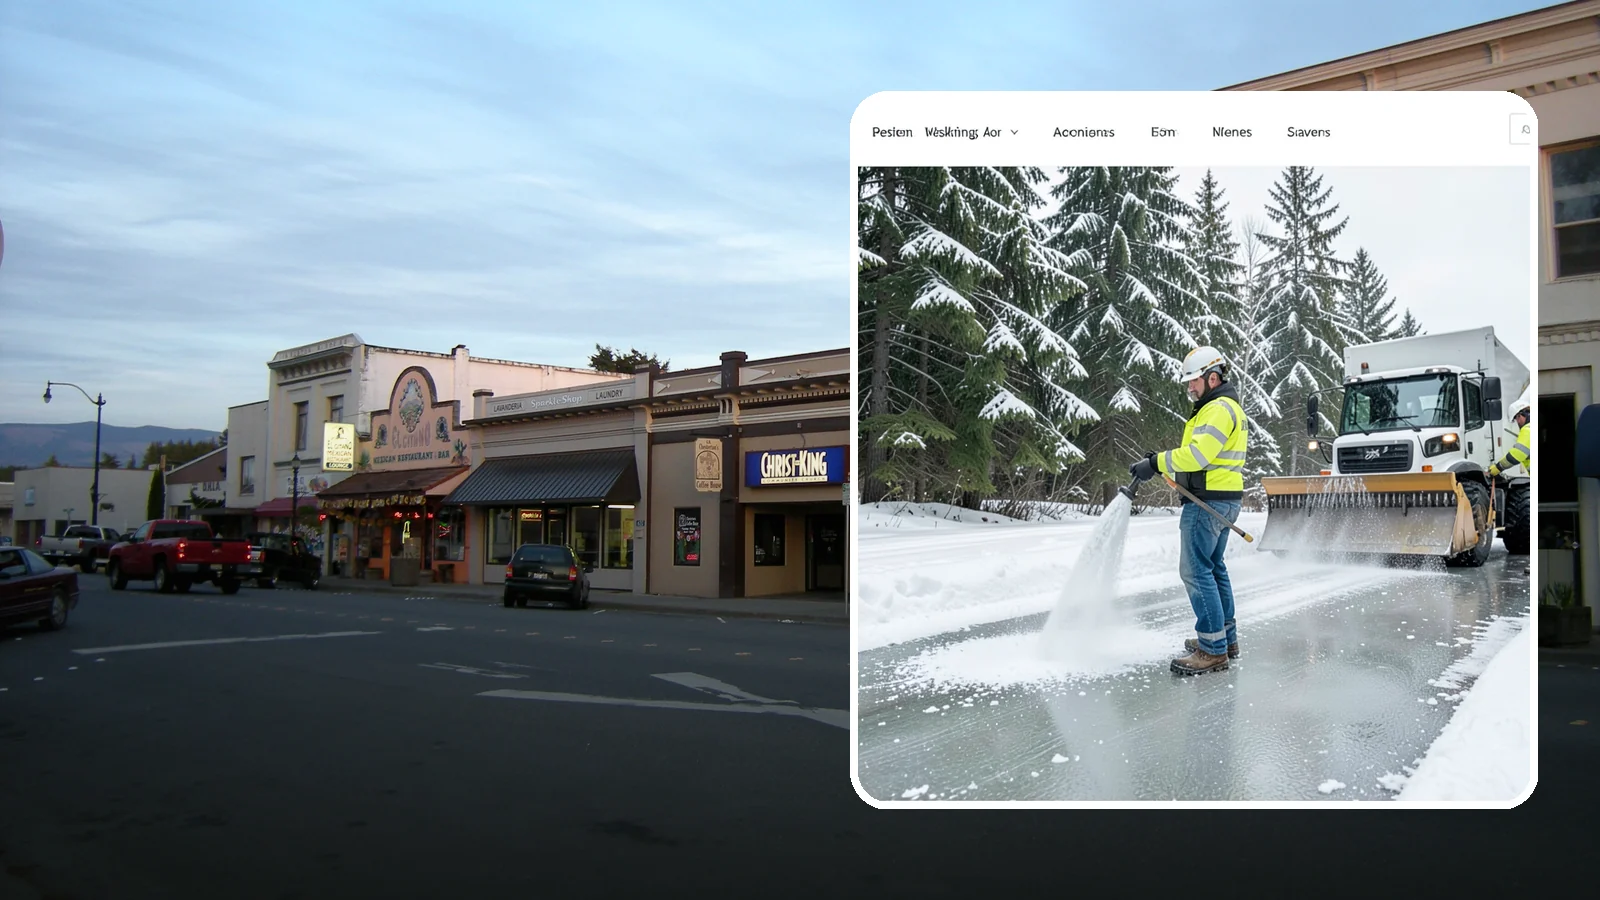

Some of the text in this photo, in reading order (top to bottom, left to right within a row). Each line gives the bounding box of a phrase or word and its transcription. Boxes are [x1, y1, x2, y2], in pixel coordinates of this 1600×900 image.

[595, 389, 624, 400] LAUNDRY
[561, 395, 583, 406] Shop
[493, 402, 523, 413] LAVANDERIA
[374, 450, 450, 464] MEXICAN RESTAURANT BAR
[760, 450, 827, 478] CHRIST KING
